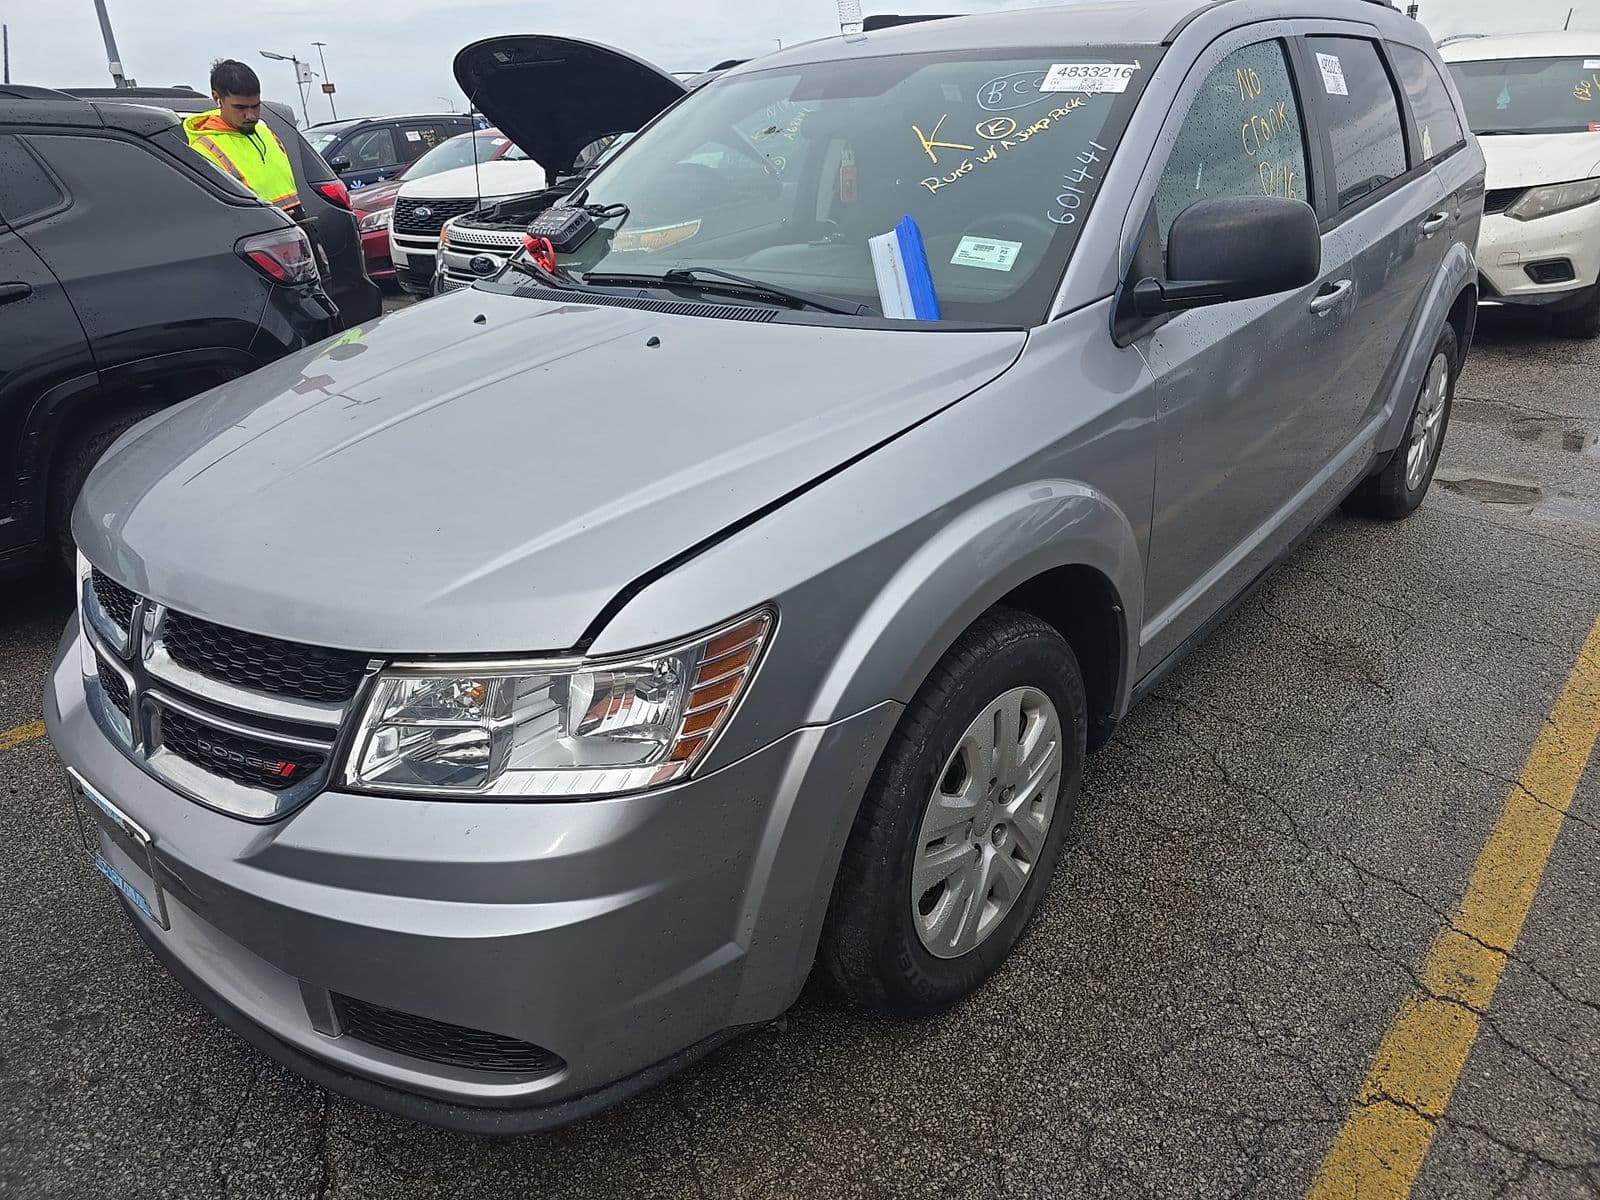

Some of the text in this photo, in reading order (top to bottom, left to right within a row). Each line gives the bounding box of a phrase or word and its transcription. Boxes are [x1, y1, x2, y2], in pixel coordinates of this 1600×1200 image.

[1057, 66, 1133, 79] 4833216
[1236, 67, 1261, 101] NO
[911, 113, 975, 164] K
[1000, 140, 1017, 151] A
[1047, 140, 1108, 225] 601441
[197, 739, 282, 775] DODGE
